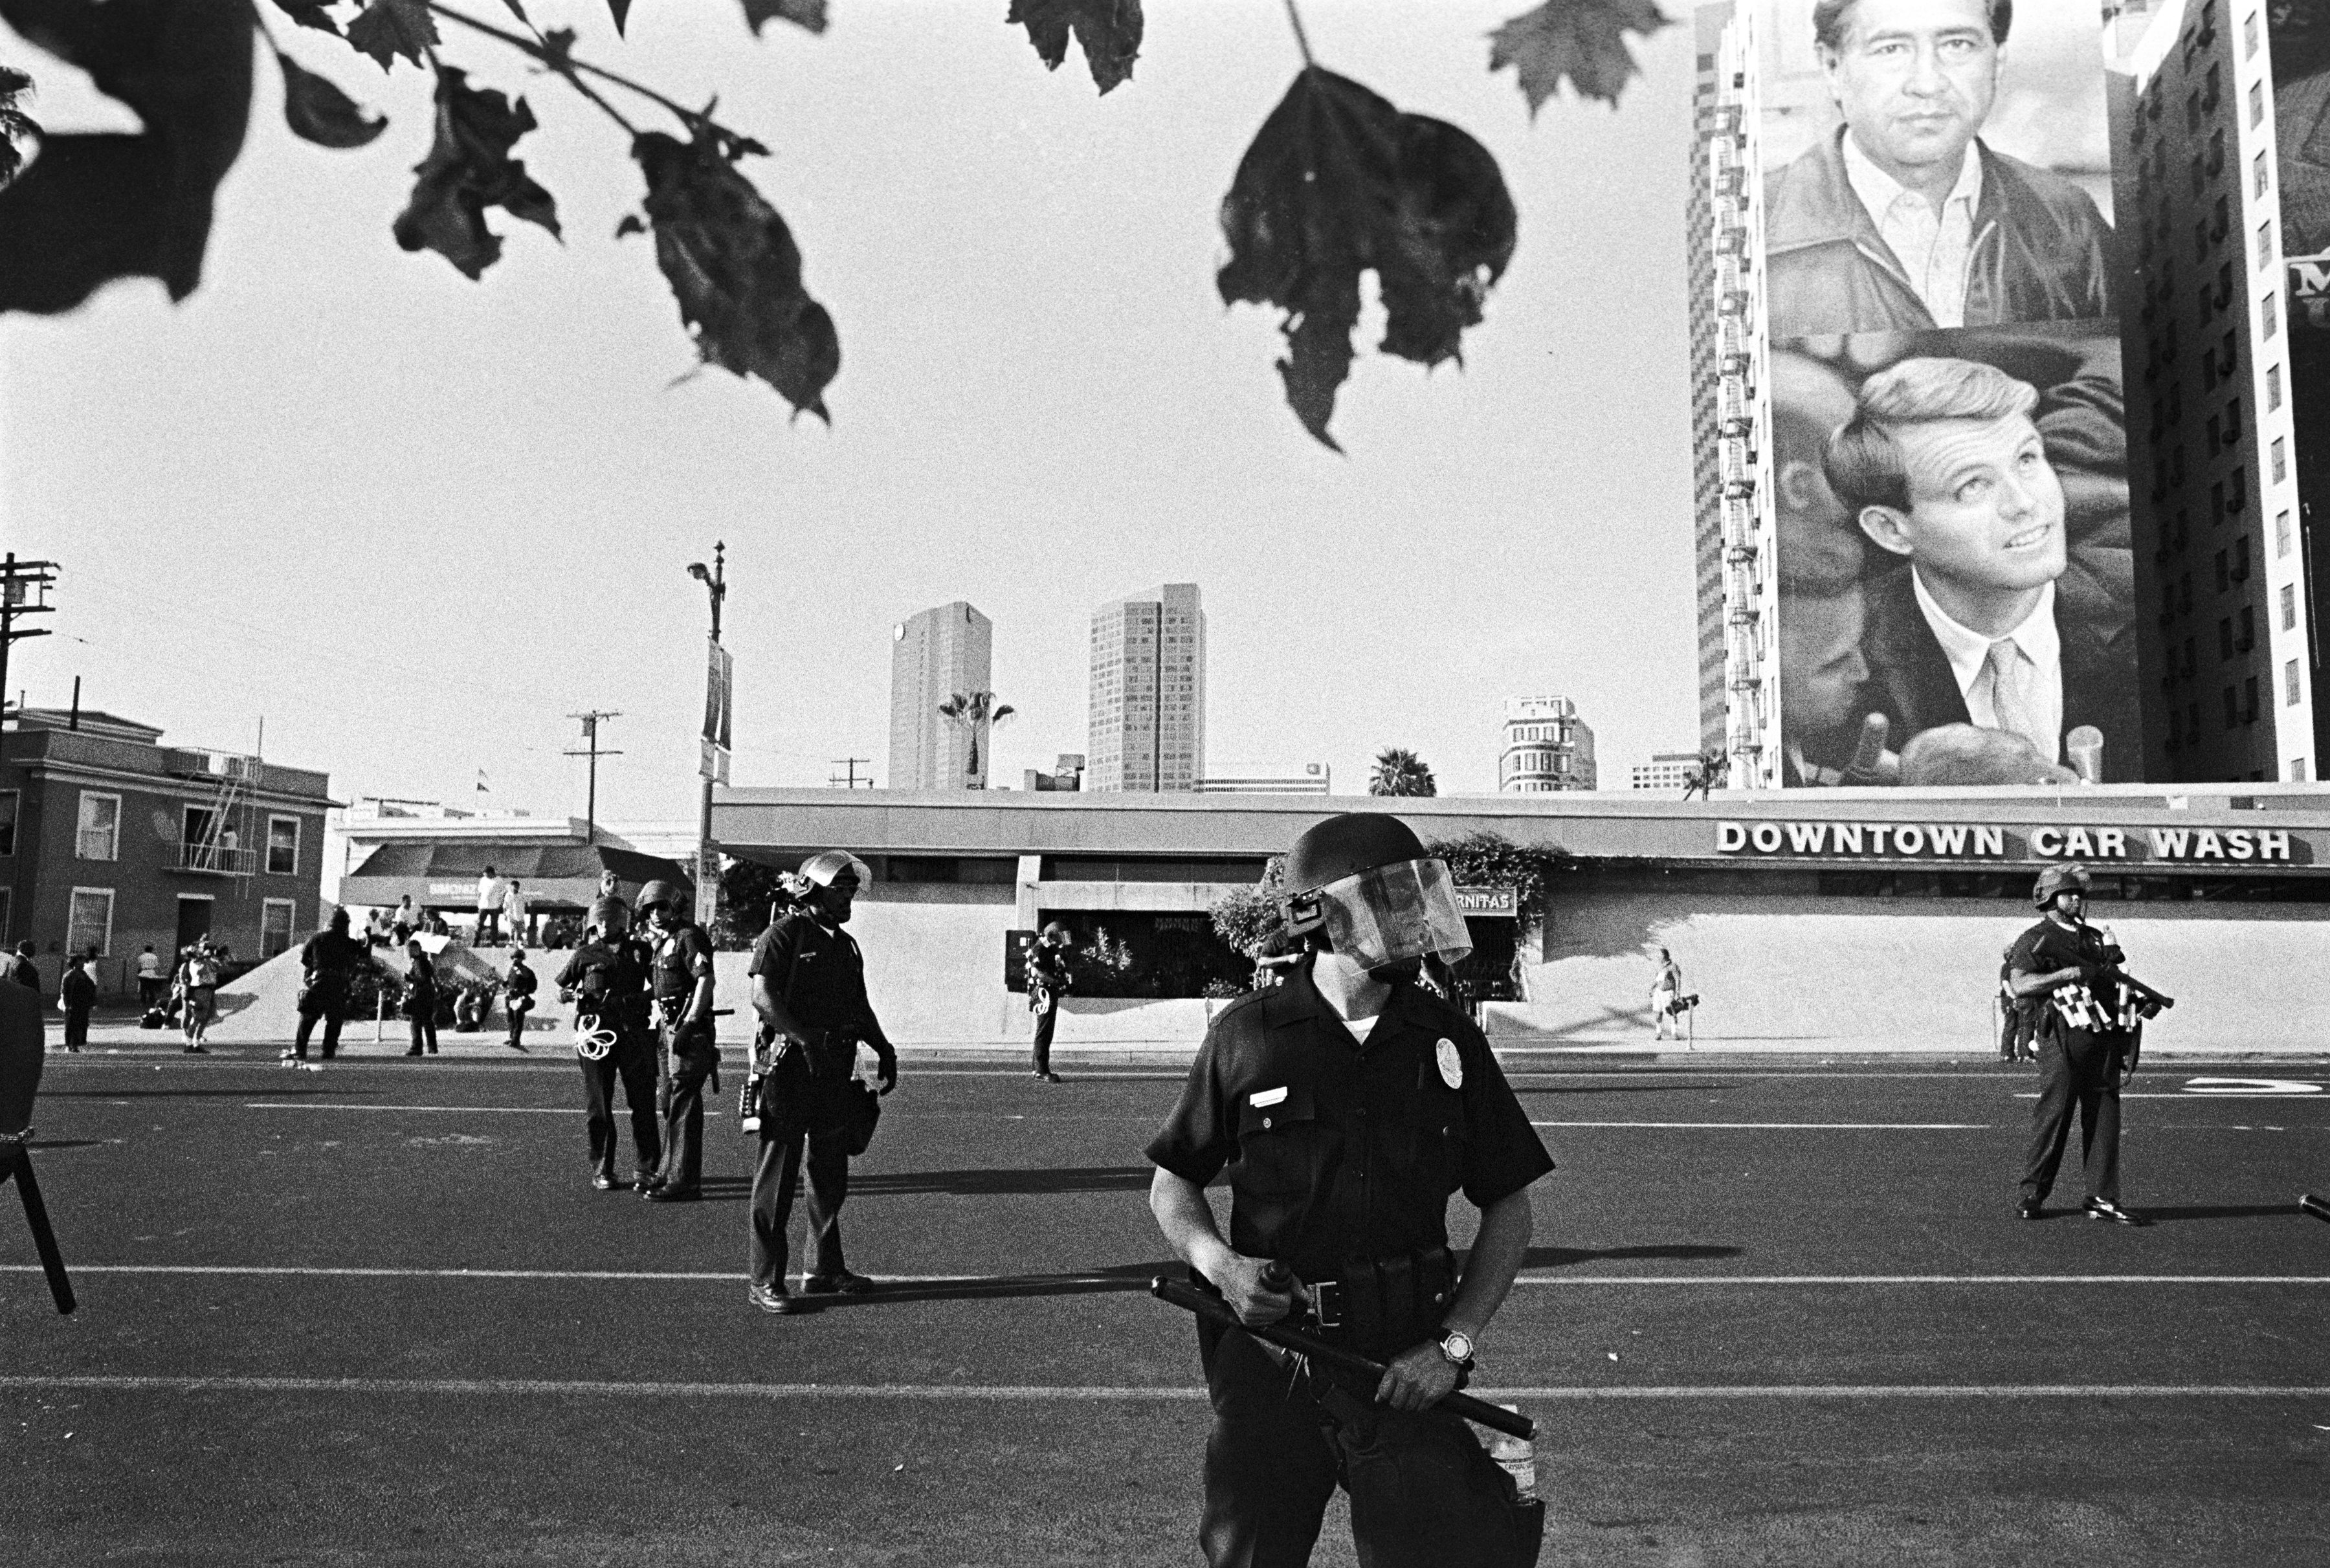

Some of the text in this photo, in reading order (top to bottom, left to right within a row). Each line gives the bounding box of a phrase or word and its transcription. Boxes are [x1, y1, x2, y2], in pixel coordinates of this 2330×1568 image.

[1718, 821, 2291, 860] DOWNTOWN CAR WASH
[703, 861, 718, 878] 35
[1456, 893, 1509, 909] RNITAS
